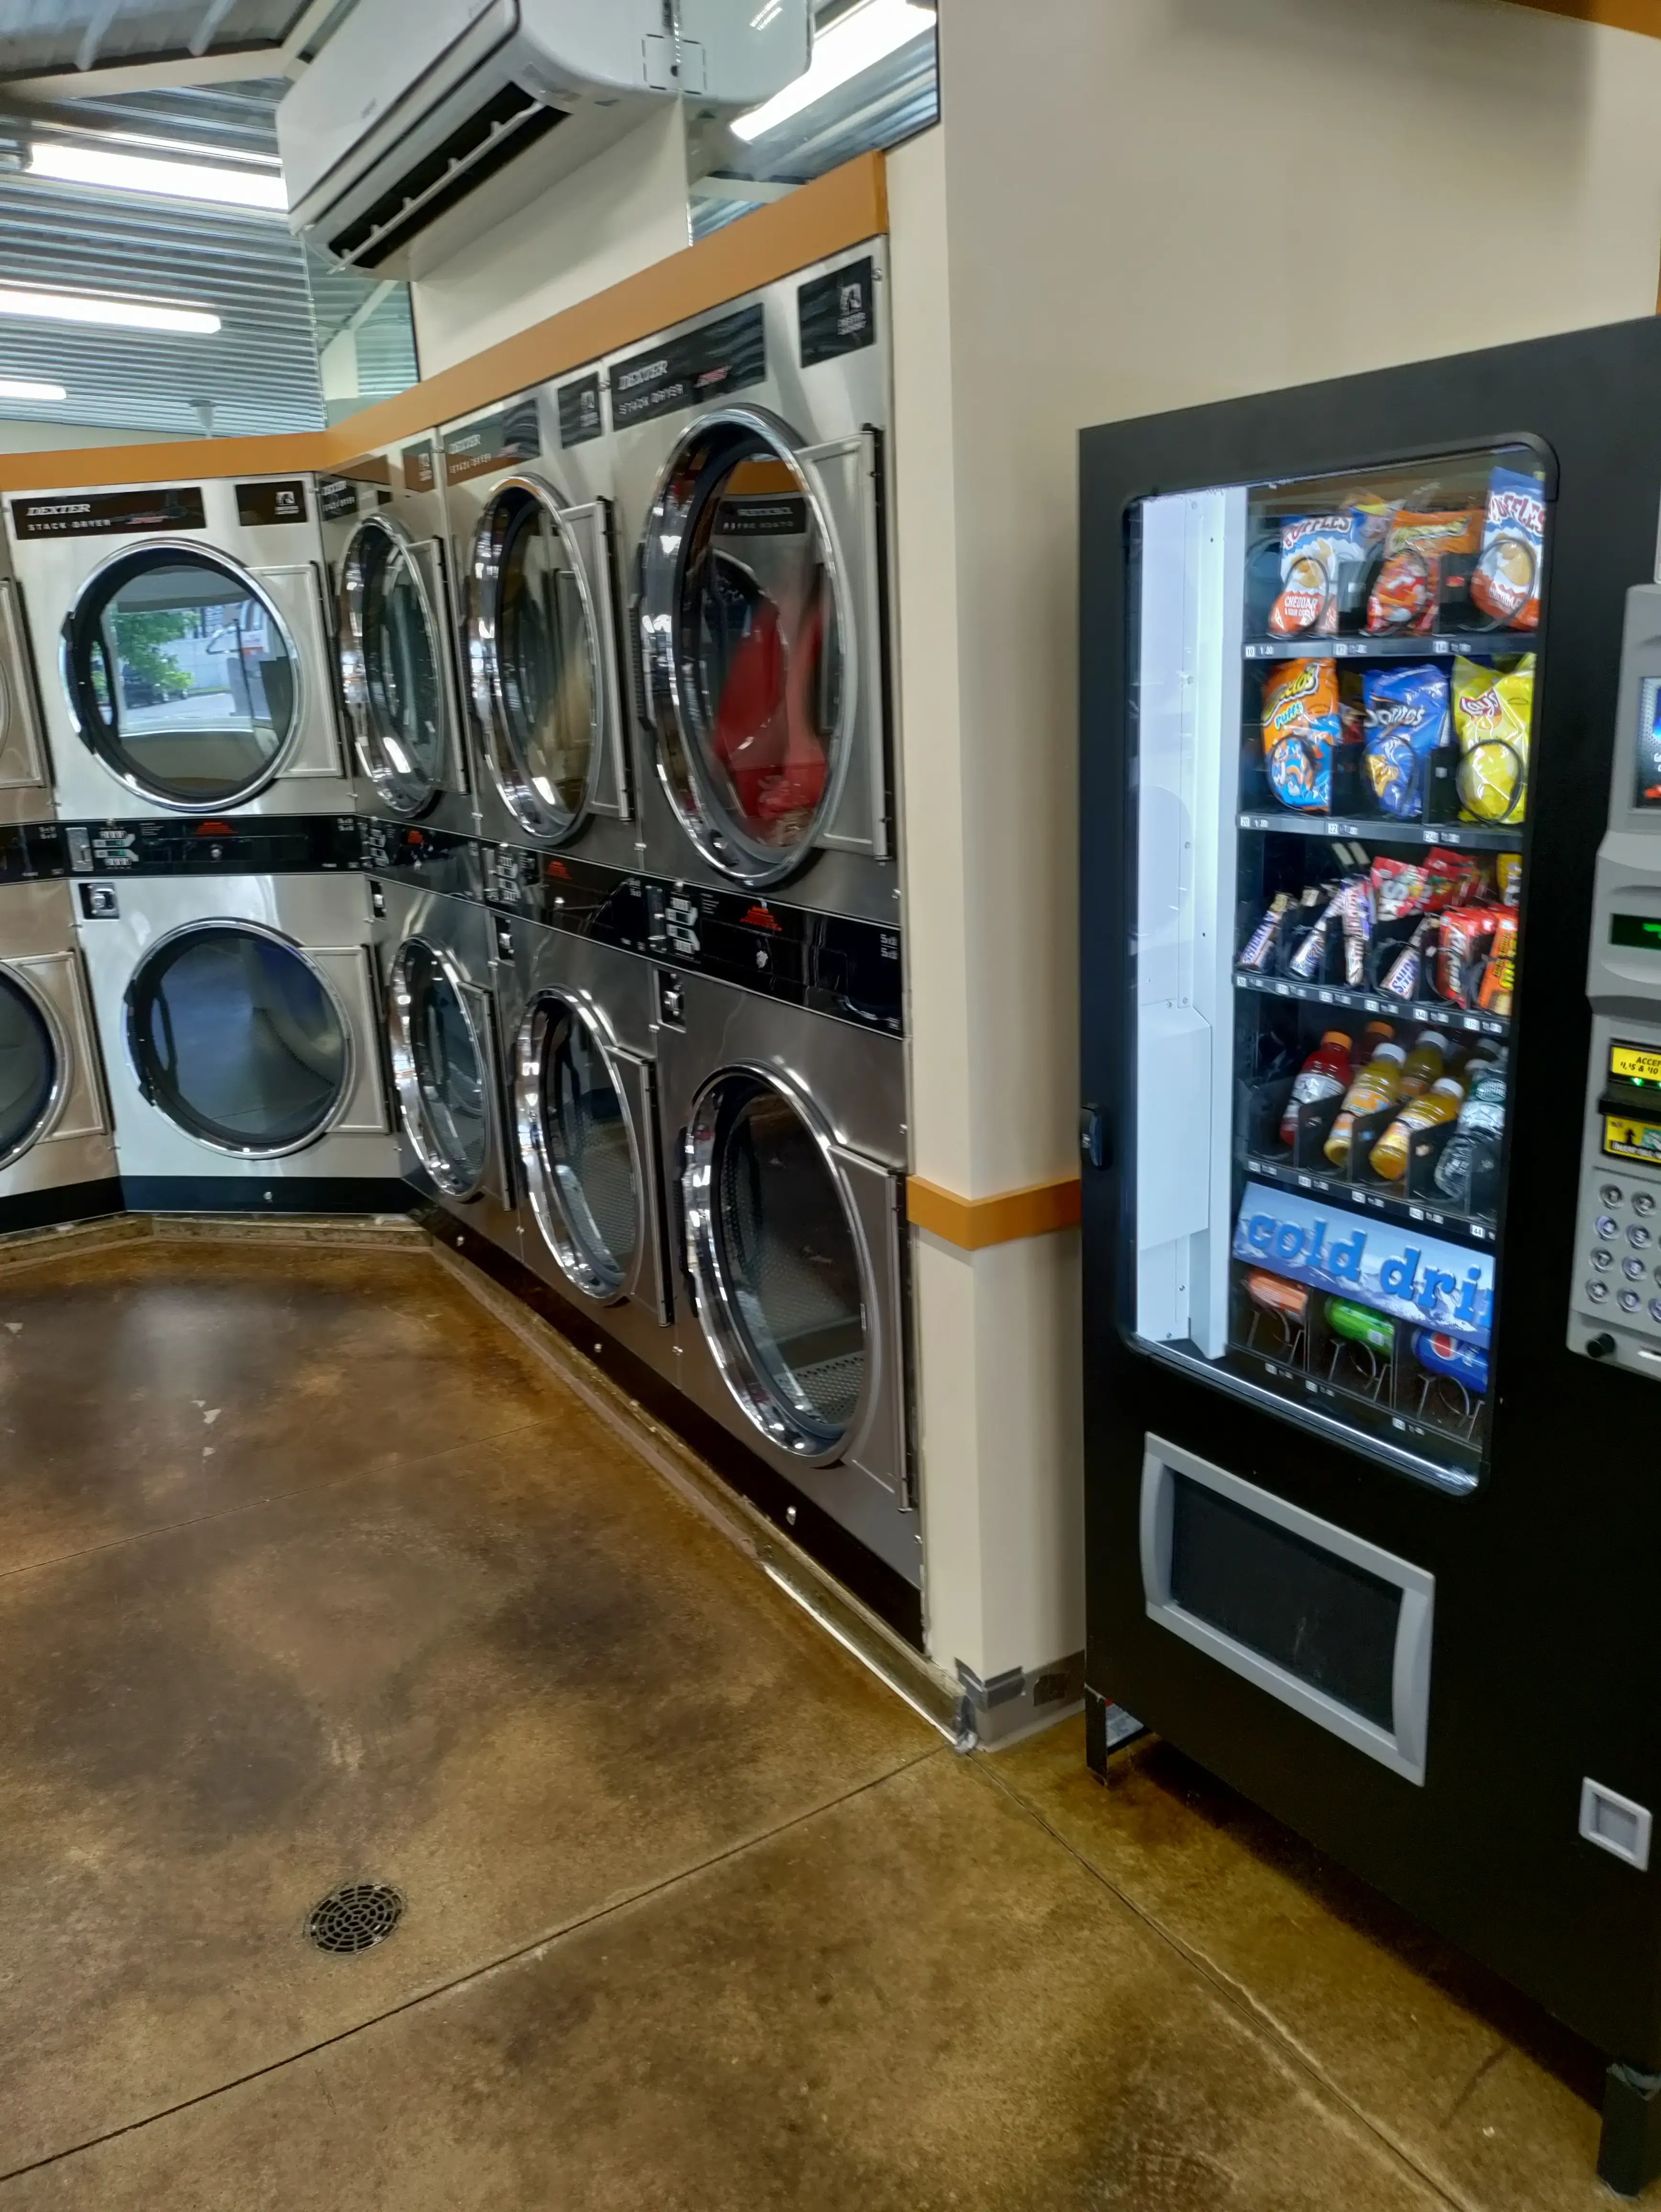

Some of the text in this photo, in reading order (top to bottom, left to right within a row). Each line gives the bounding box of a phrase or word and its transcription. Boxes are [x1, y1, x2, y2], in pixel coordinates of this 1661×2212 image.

[25, 504, 91, 516] DEXTER
[27, 519, 111, 531] STACK DRYER
[1248, 1212, 1367, 1283] cold
